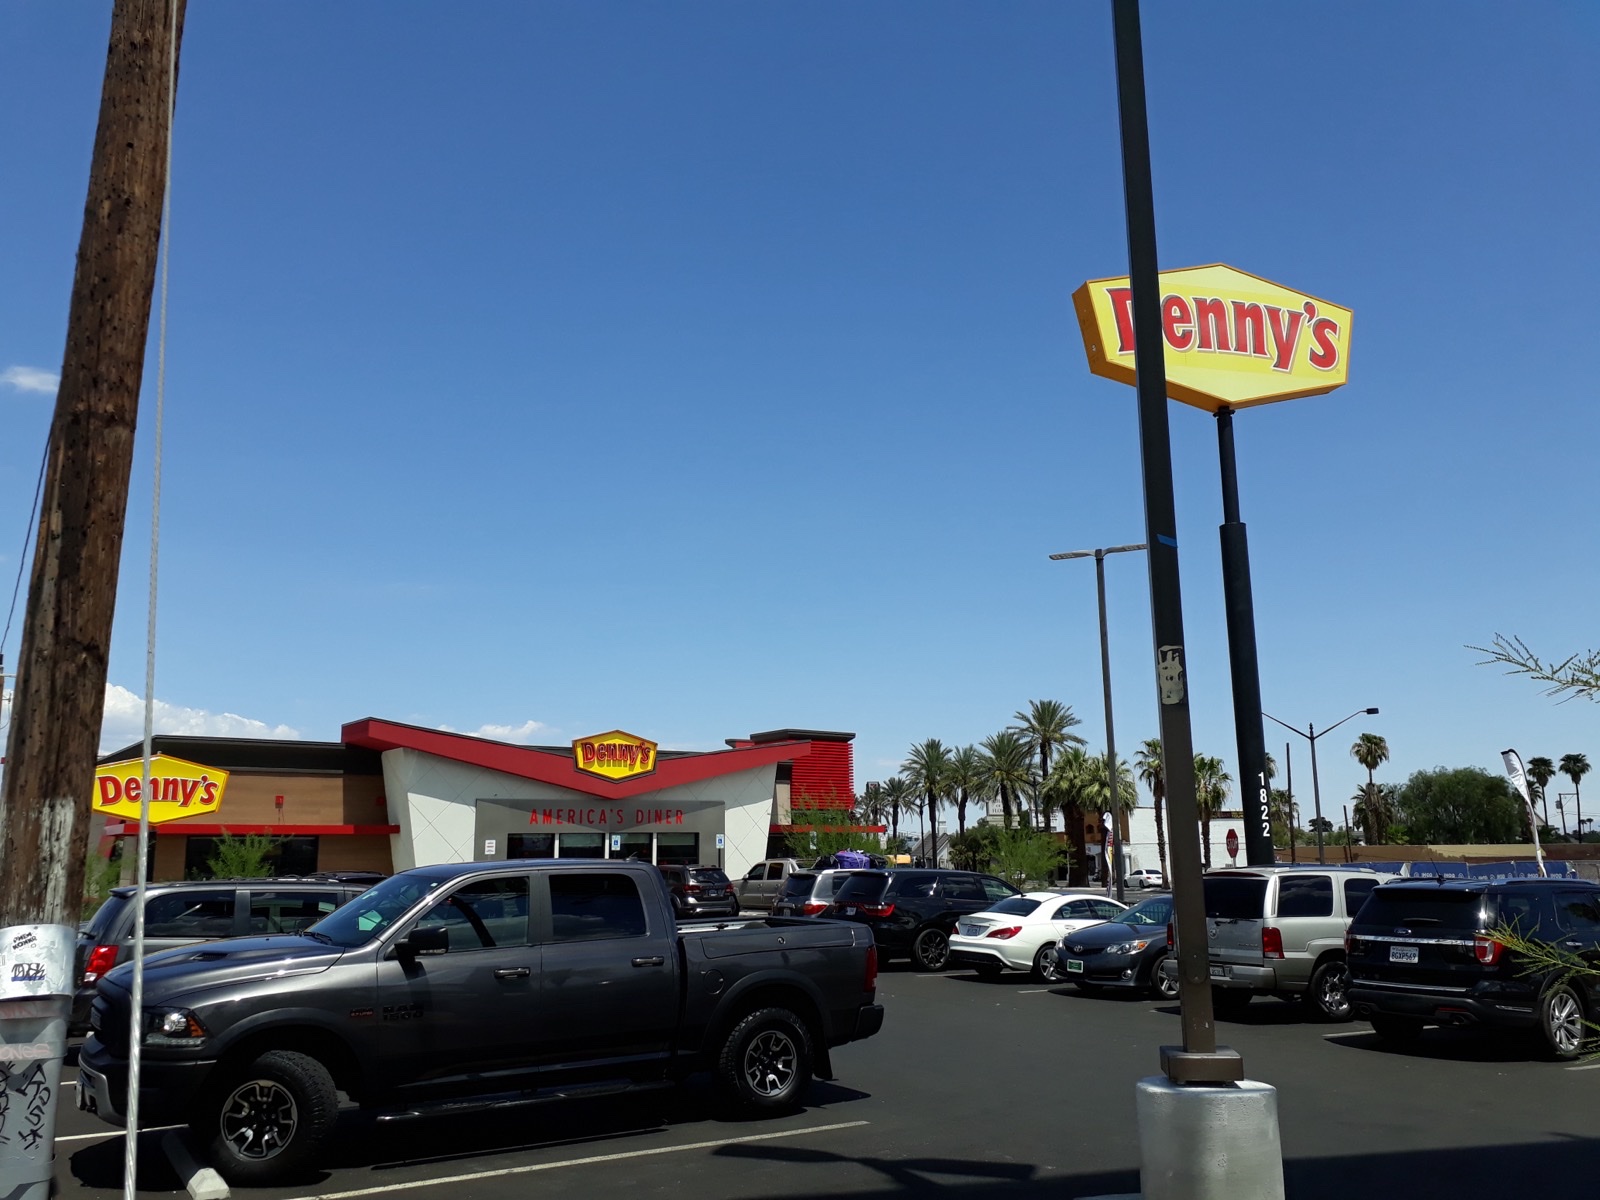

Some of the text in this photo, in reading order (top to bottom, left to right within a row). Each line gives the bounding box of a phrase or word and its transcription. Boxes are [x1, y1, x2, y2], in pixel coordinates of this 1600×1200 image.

[581, 741, 652, 765] Denny's
[98, 774, 219, 808] Denny's
[1258, 771, 1271, 838] 1822
[529, 808, 684, 825] AMERICA'S DINER
